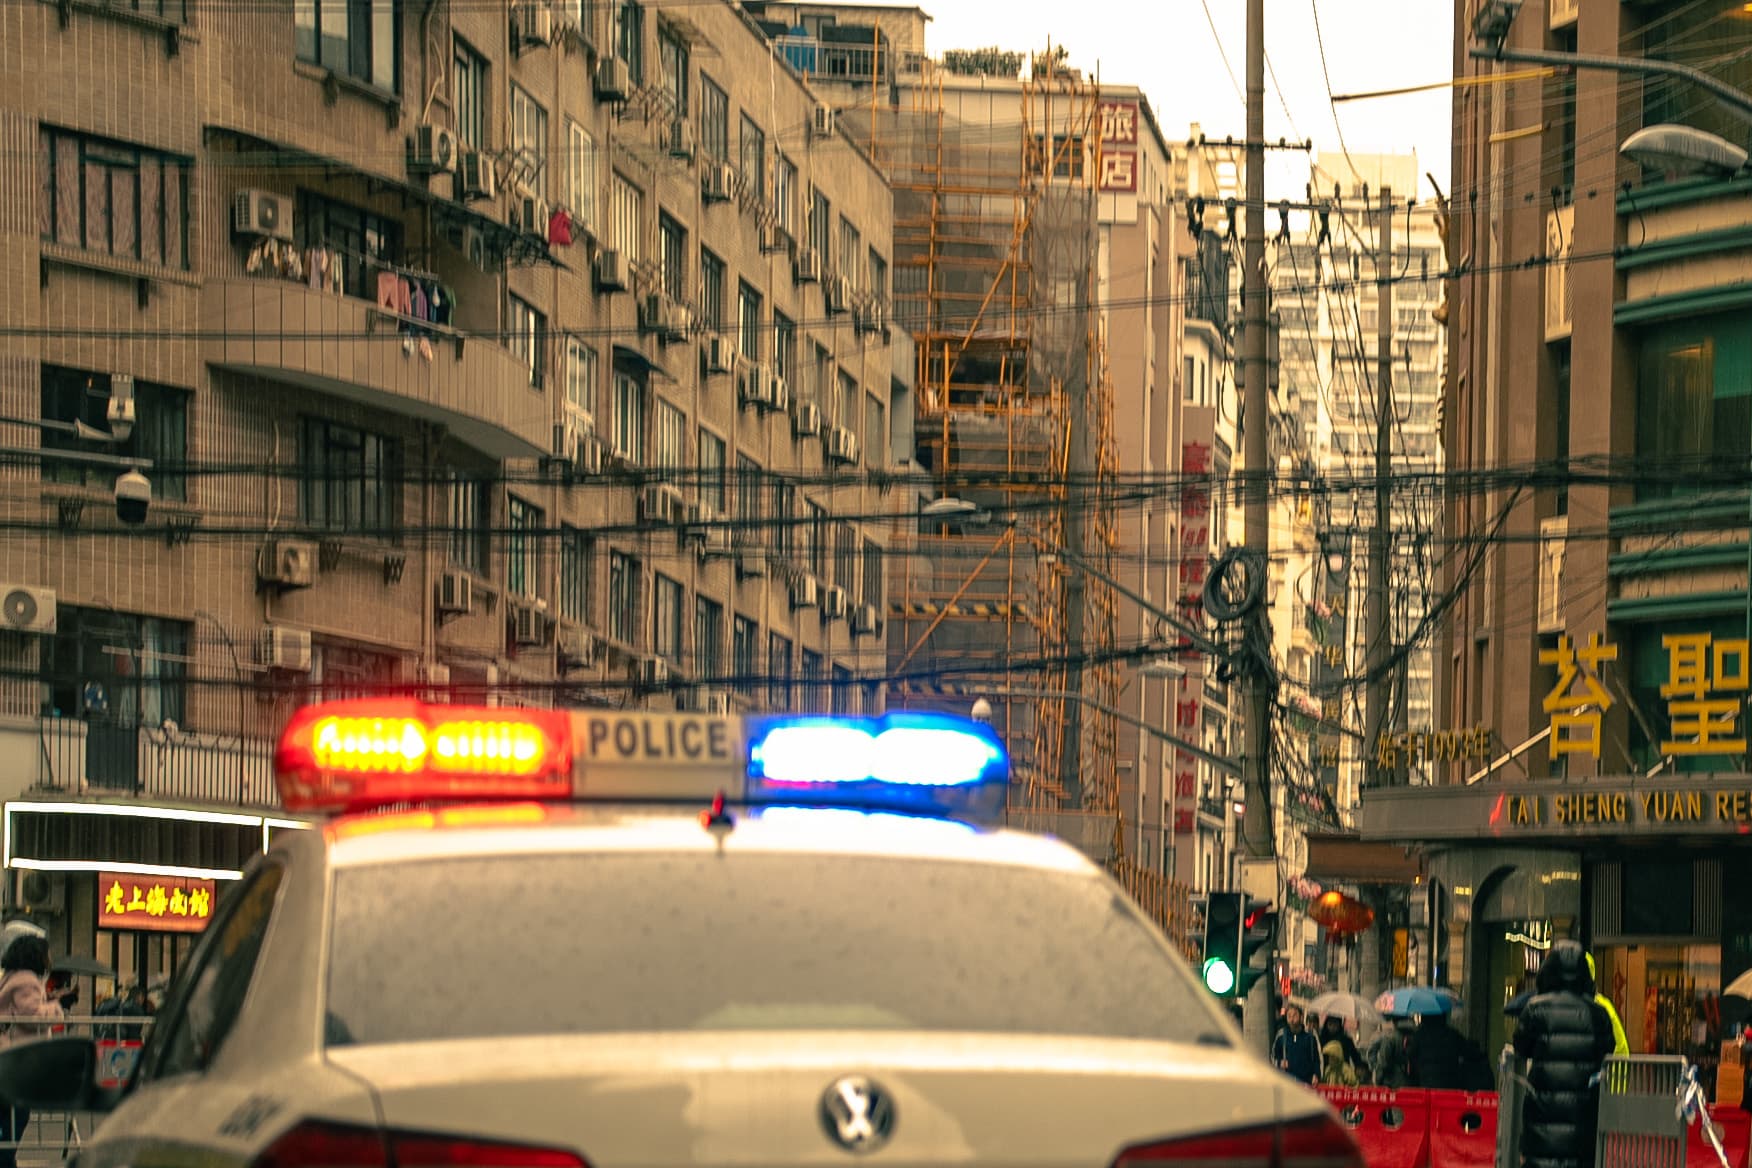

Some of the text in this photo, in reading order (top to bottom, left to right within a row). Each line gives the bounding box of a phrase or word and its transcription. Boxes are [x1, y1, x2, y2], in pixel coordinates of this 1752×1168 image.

[1100, 104, 1134, 187] 旅店
[588, 719, 727, 757] POLICE
[1506, 793, 1540, 825] TAI
[1554, 791, 1627, 824] SHENG
[1641, 791, 1701, 823] YUAN
